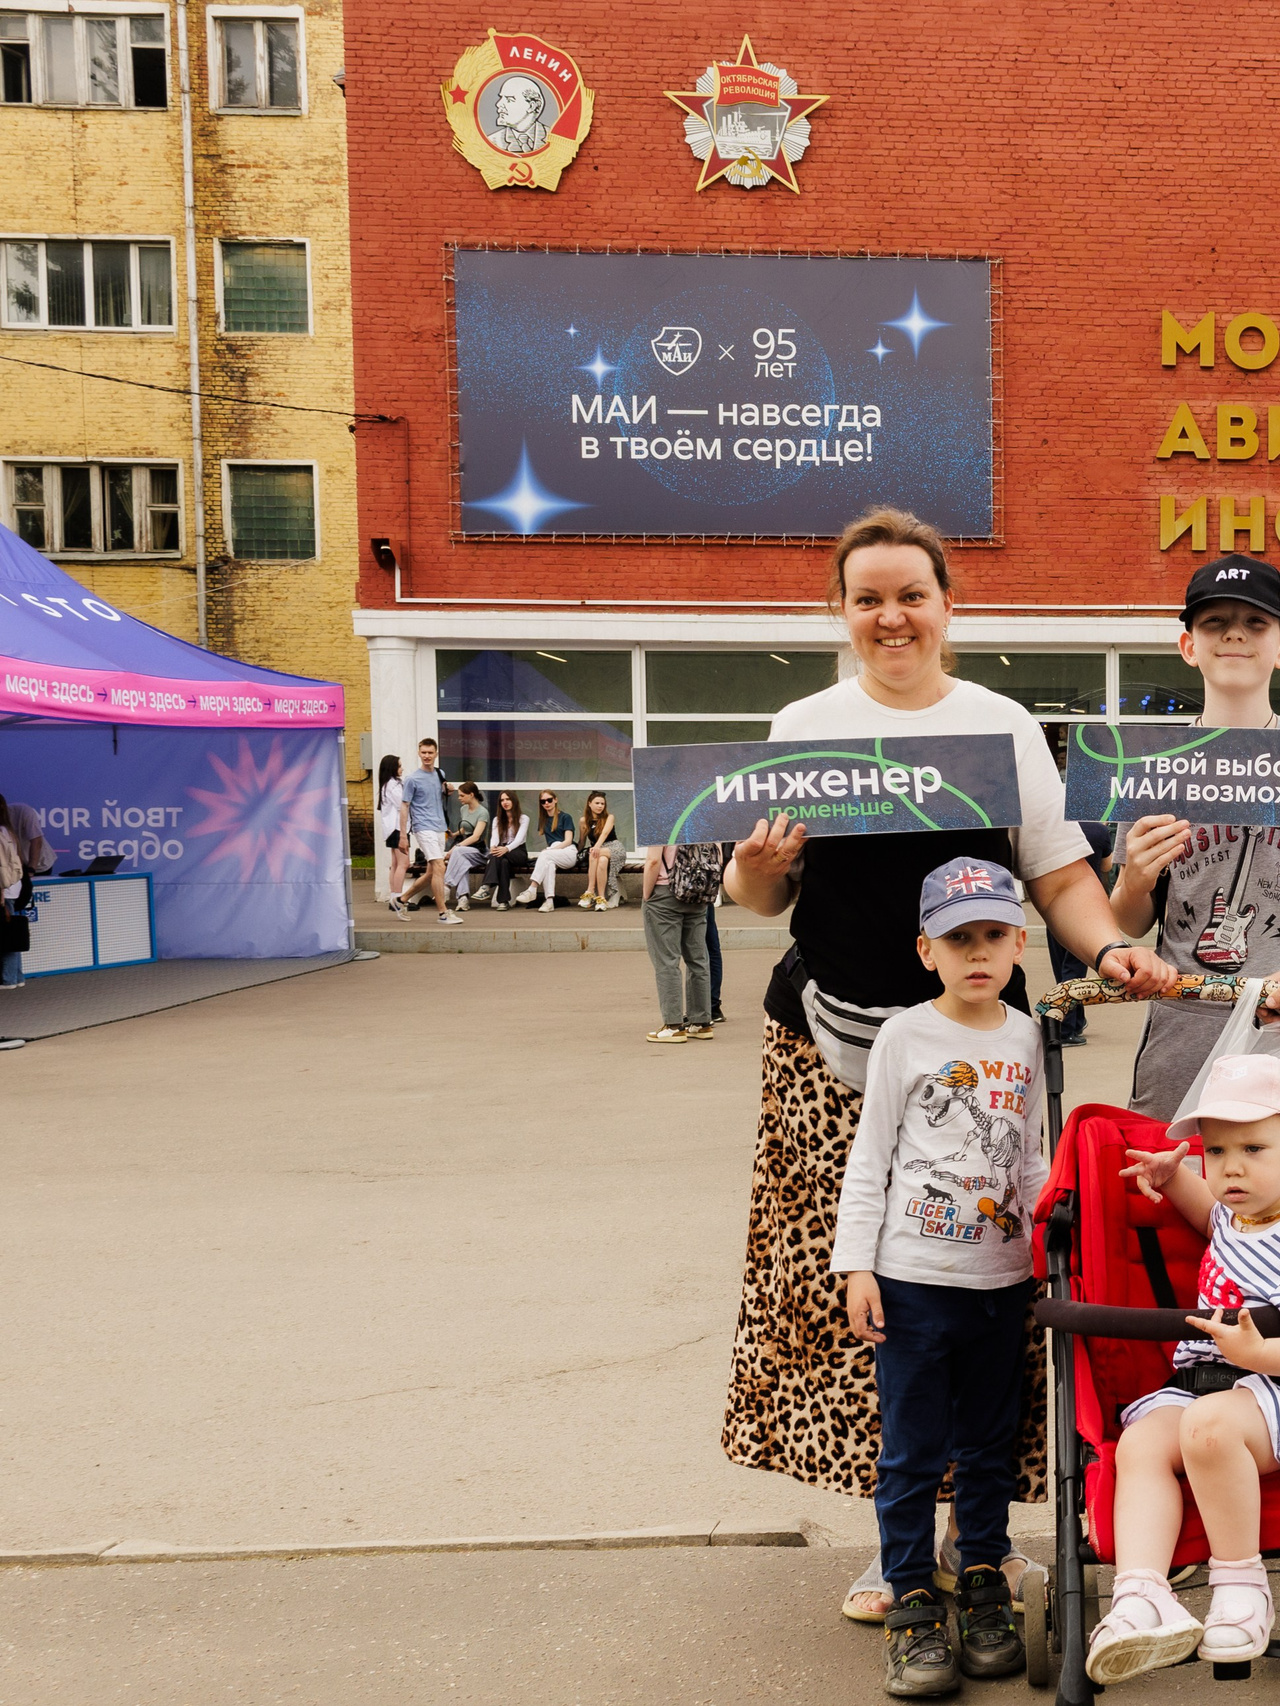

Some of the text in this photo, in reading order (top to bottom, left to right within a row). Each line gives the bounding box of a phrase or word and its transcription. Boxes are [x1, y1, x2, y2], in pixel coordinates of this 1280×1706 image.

[509, 46, 573, 82] ЛЕНИН
[721, 74, 778, 89] ОКТЯБРЬСКАЯ
[723, 86, 776, 100] РЕВОЛЮЦИЯ
[752, 328, 797, 360] 95
[754, 360, 797, 378] лет
[571, 394, 658, 425] МАИ
[717, 399, 882, 432] навсегда
[581, 430, 874, 467] в твоём сердце!
[1215, 568, 1250, 582] ART
[5, 674, 329, 718] мерч здесь мерч здесь мерч здесь мерч здесь
[1141, 752, 1208, 775] твой
[715, 764, 943, 804] инженер
[1110, 777, 1177, 800] МАИ
[768, 801, 894, 821] поменьше
[1180, 849, 1230, 880] ONLY BEST
[1257, 878, 1273, 889] NEW
[1014, 1083, 1027, 1098] AN
[989, 1091, 1026, 1119] FRE
[912, 1200, 956, 1221] TIGER
[924, 1220, 984, 1241] SKATER
